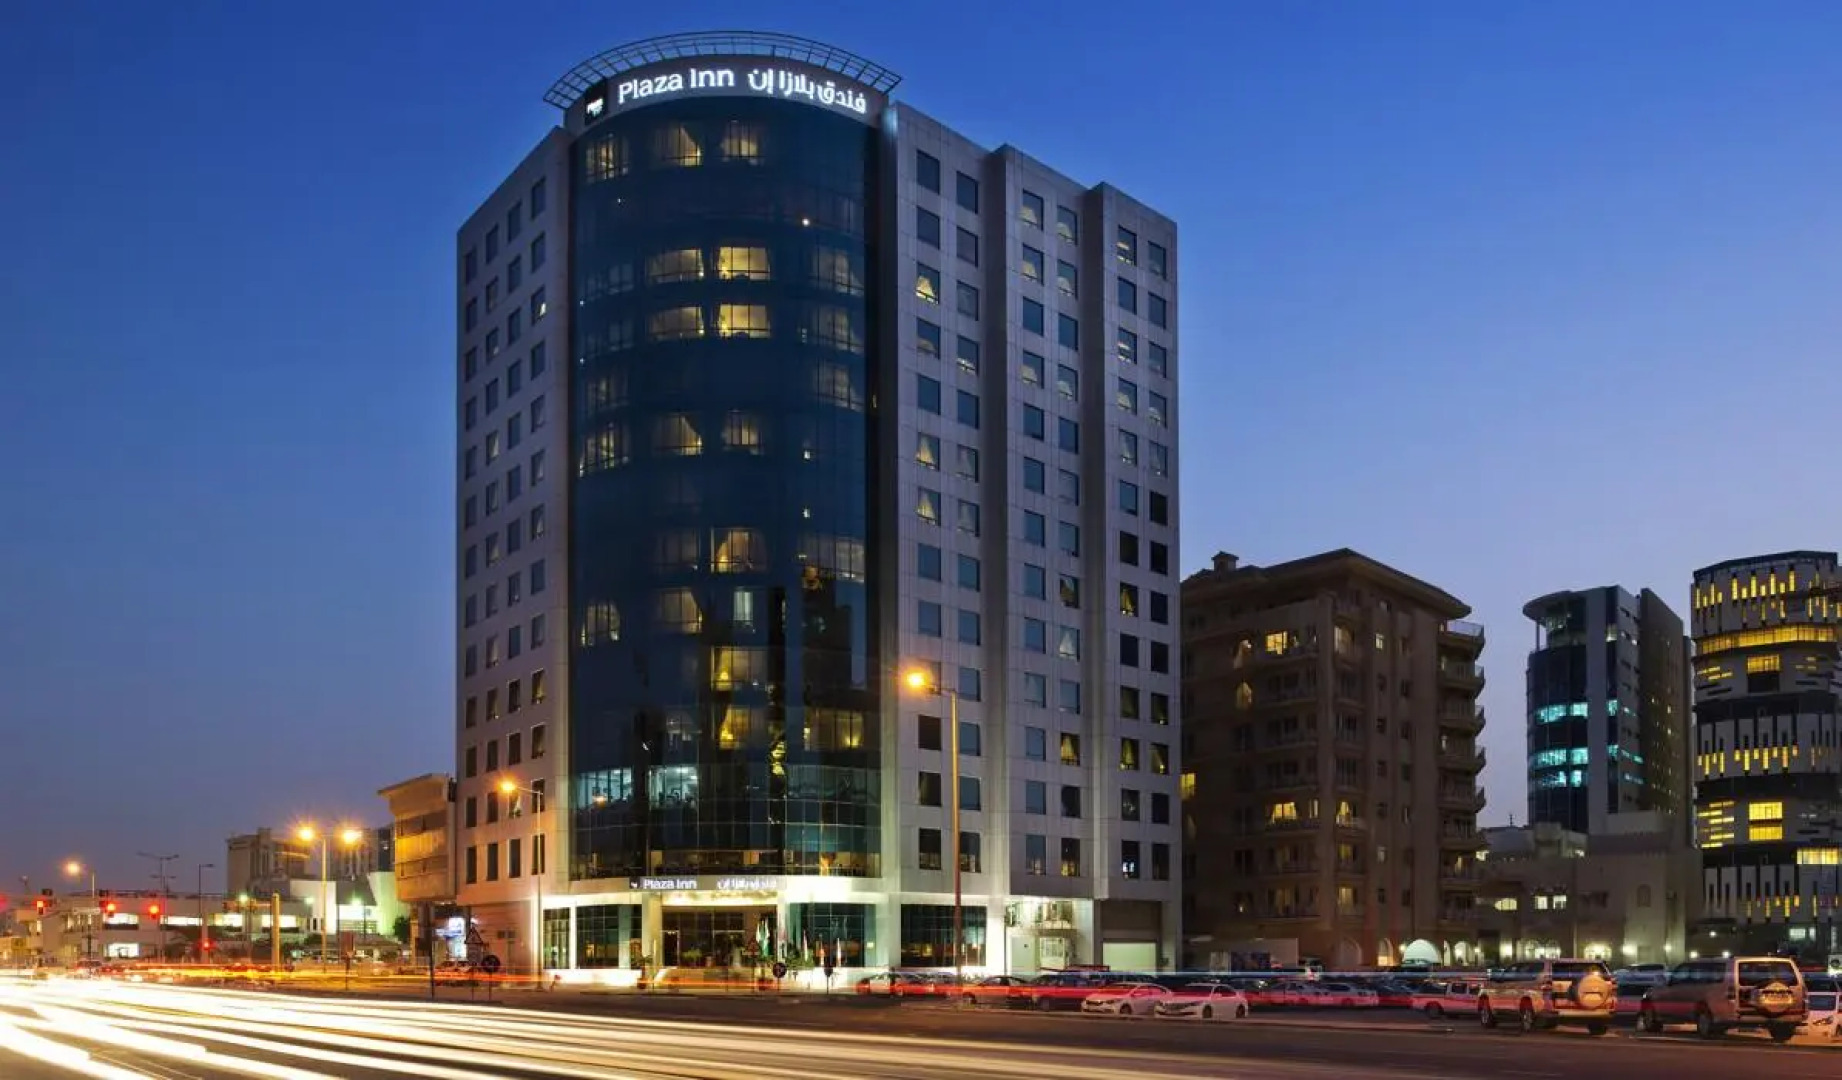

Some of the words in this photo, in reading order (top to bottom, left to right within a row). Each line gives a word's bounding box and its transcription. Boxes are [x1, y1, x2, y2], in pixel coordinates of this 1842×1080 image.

[618, 73, 683, 104] Plaza
[689, 67, 736, 88] Inn
[778, 69, 815, 100] بلازا
[817, 80, 867, 114] فندق
[643, 878, 675, 890] Plaza
[676, 878, 697, 890] Inn
